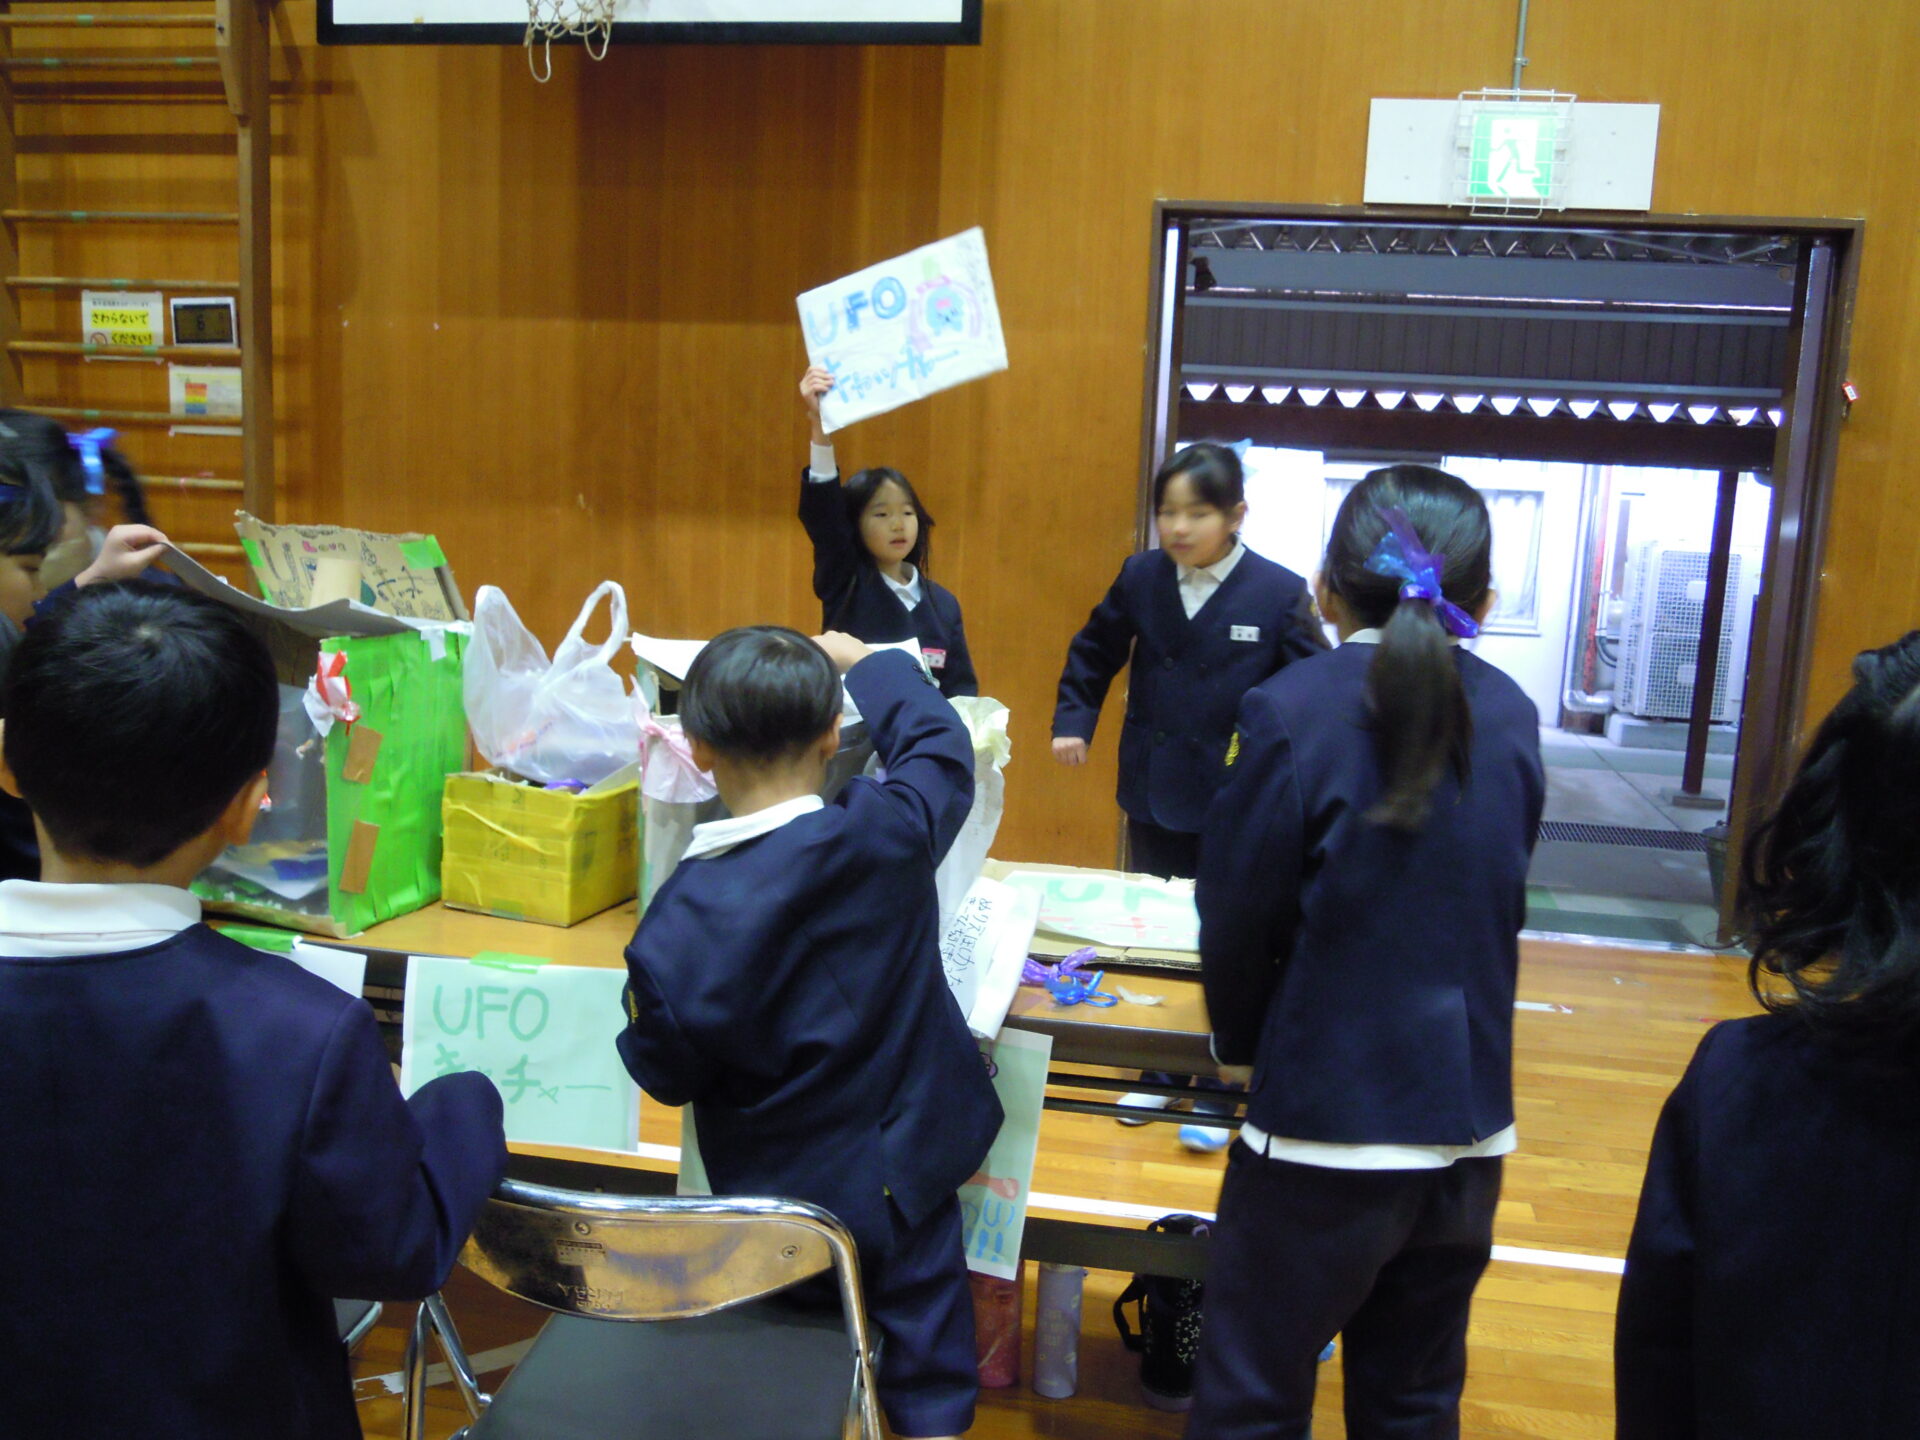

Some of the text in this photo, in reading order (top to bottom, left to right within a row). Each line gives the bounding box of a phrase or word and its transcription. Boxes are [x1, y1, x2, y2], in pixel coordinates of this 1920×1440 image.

[91, 311, 150, 325] さわらないで
[807, 276, 906, 346] UFO
[432, 984, 549, 1041] UFO
